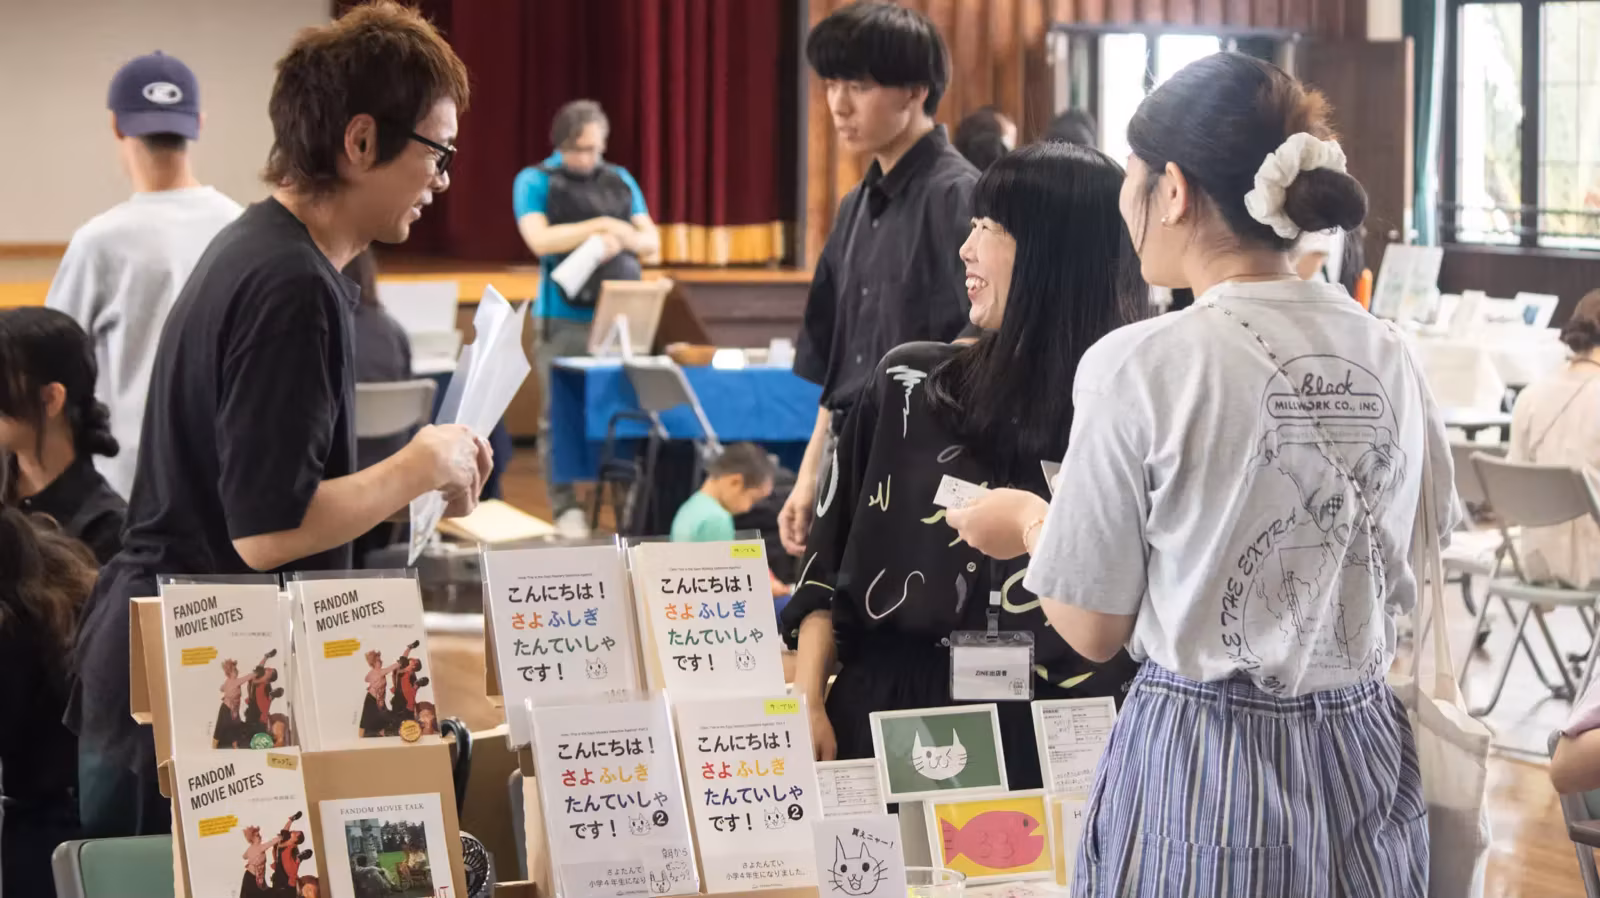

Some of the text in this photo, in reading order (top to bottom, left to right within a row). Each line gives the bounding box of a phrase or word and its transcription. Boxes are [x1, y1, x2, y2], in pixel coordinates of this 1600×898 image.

[1300, 369, 1354, 395] Black
[1274, 400, 1331, 411] MILLWORK
[1360, 400, 1379, 412] INC.
[1238, 506, 1296, 576] EXTRA
[508, 581, 606, 603] こんにちは！
[661, 574, 754, 595] こんにちは！
[173, 596, 218, 620] FANDOM
[313, 590, 359, 614] FANDOM
[174, 608, 244, 639] MOVIE NOTES
[316, 601, 385, 633] MOVIE NOTES
[513, 636, 617, 656] たんていしゃ
[668, 627, 764, 646] たんていしゃ
[517, 663, 564, 682] です！
[673, 653, 715, 672] です！
[558, 736, 655, 760] こんにちは！
[698, 730, 792, 753] こんにちは！
[188, 763, 236, 792] FANDOM
[190, 785, 227, 810] MOVIE
[228, 773, 265, 797] NOTES
[565, 790, 668, 814] たんていしゃ
[704, 784, 804, 806] たんていしゃ
[340, 803, 425, 816] FANDOM MOVIE TALK
[569, 819, 617, 840] です！
[709, 812, 753, 832] です！
[742, 860, 784, 869] さよたんてい
